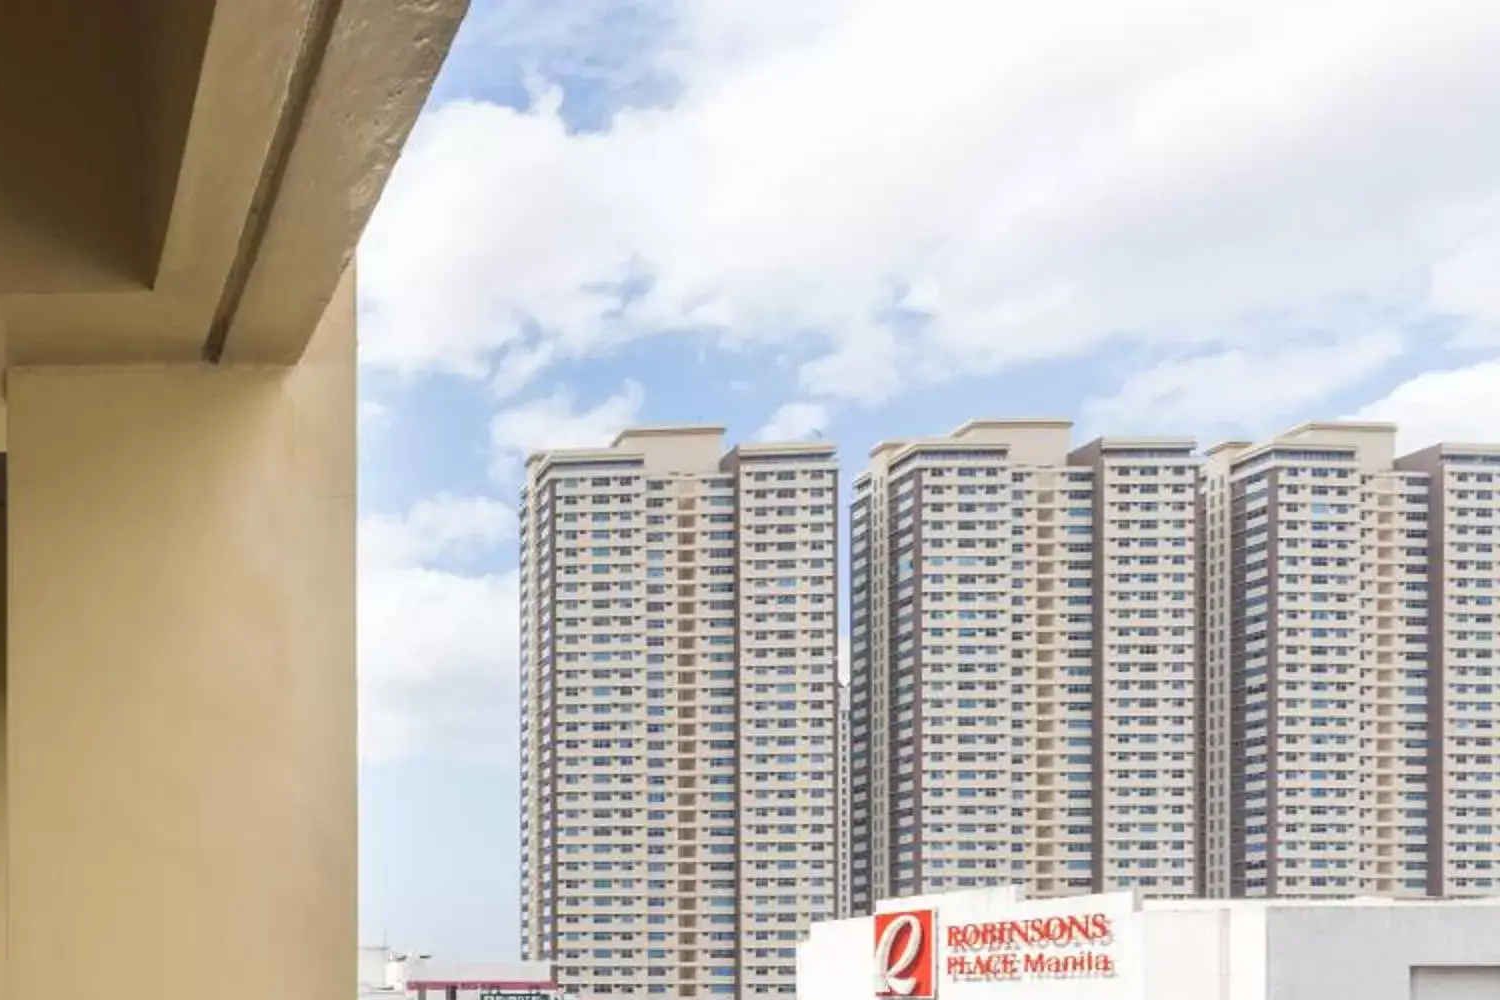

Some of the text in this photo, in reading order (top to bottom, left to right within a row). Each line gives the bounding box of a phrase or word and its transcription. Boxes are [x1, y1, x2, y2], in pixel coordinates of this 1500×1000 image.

[947, 913, 1108, 947] ROBINSONS
[947, 951, 1110, 975] PLACE Manila
